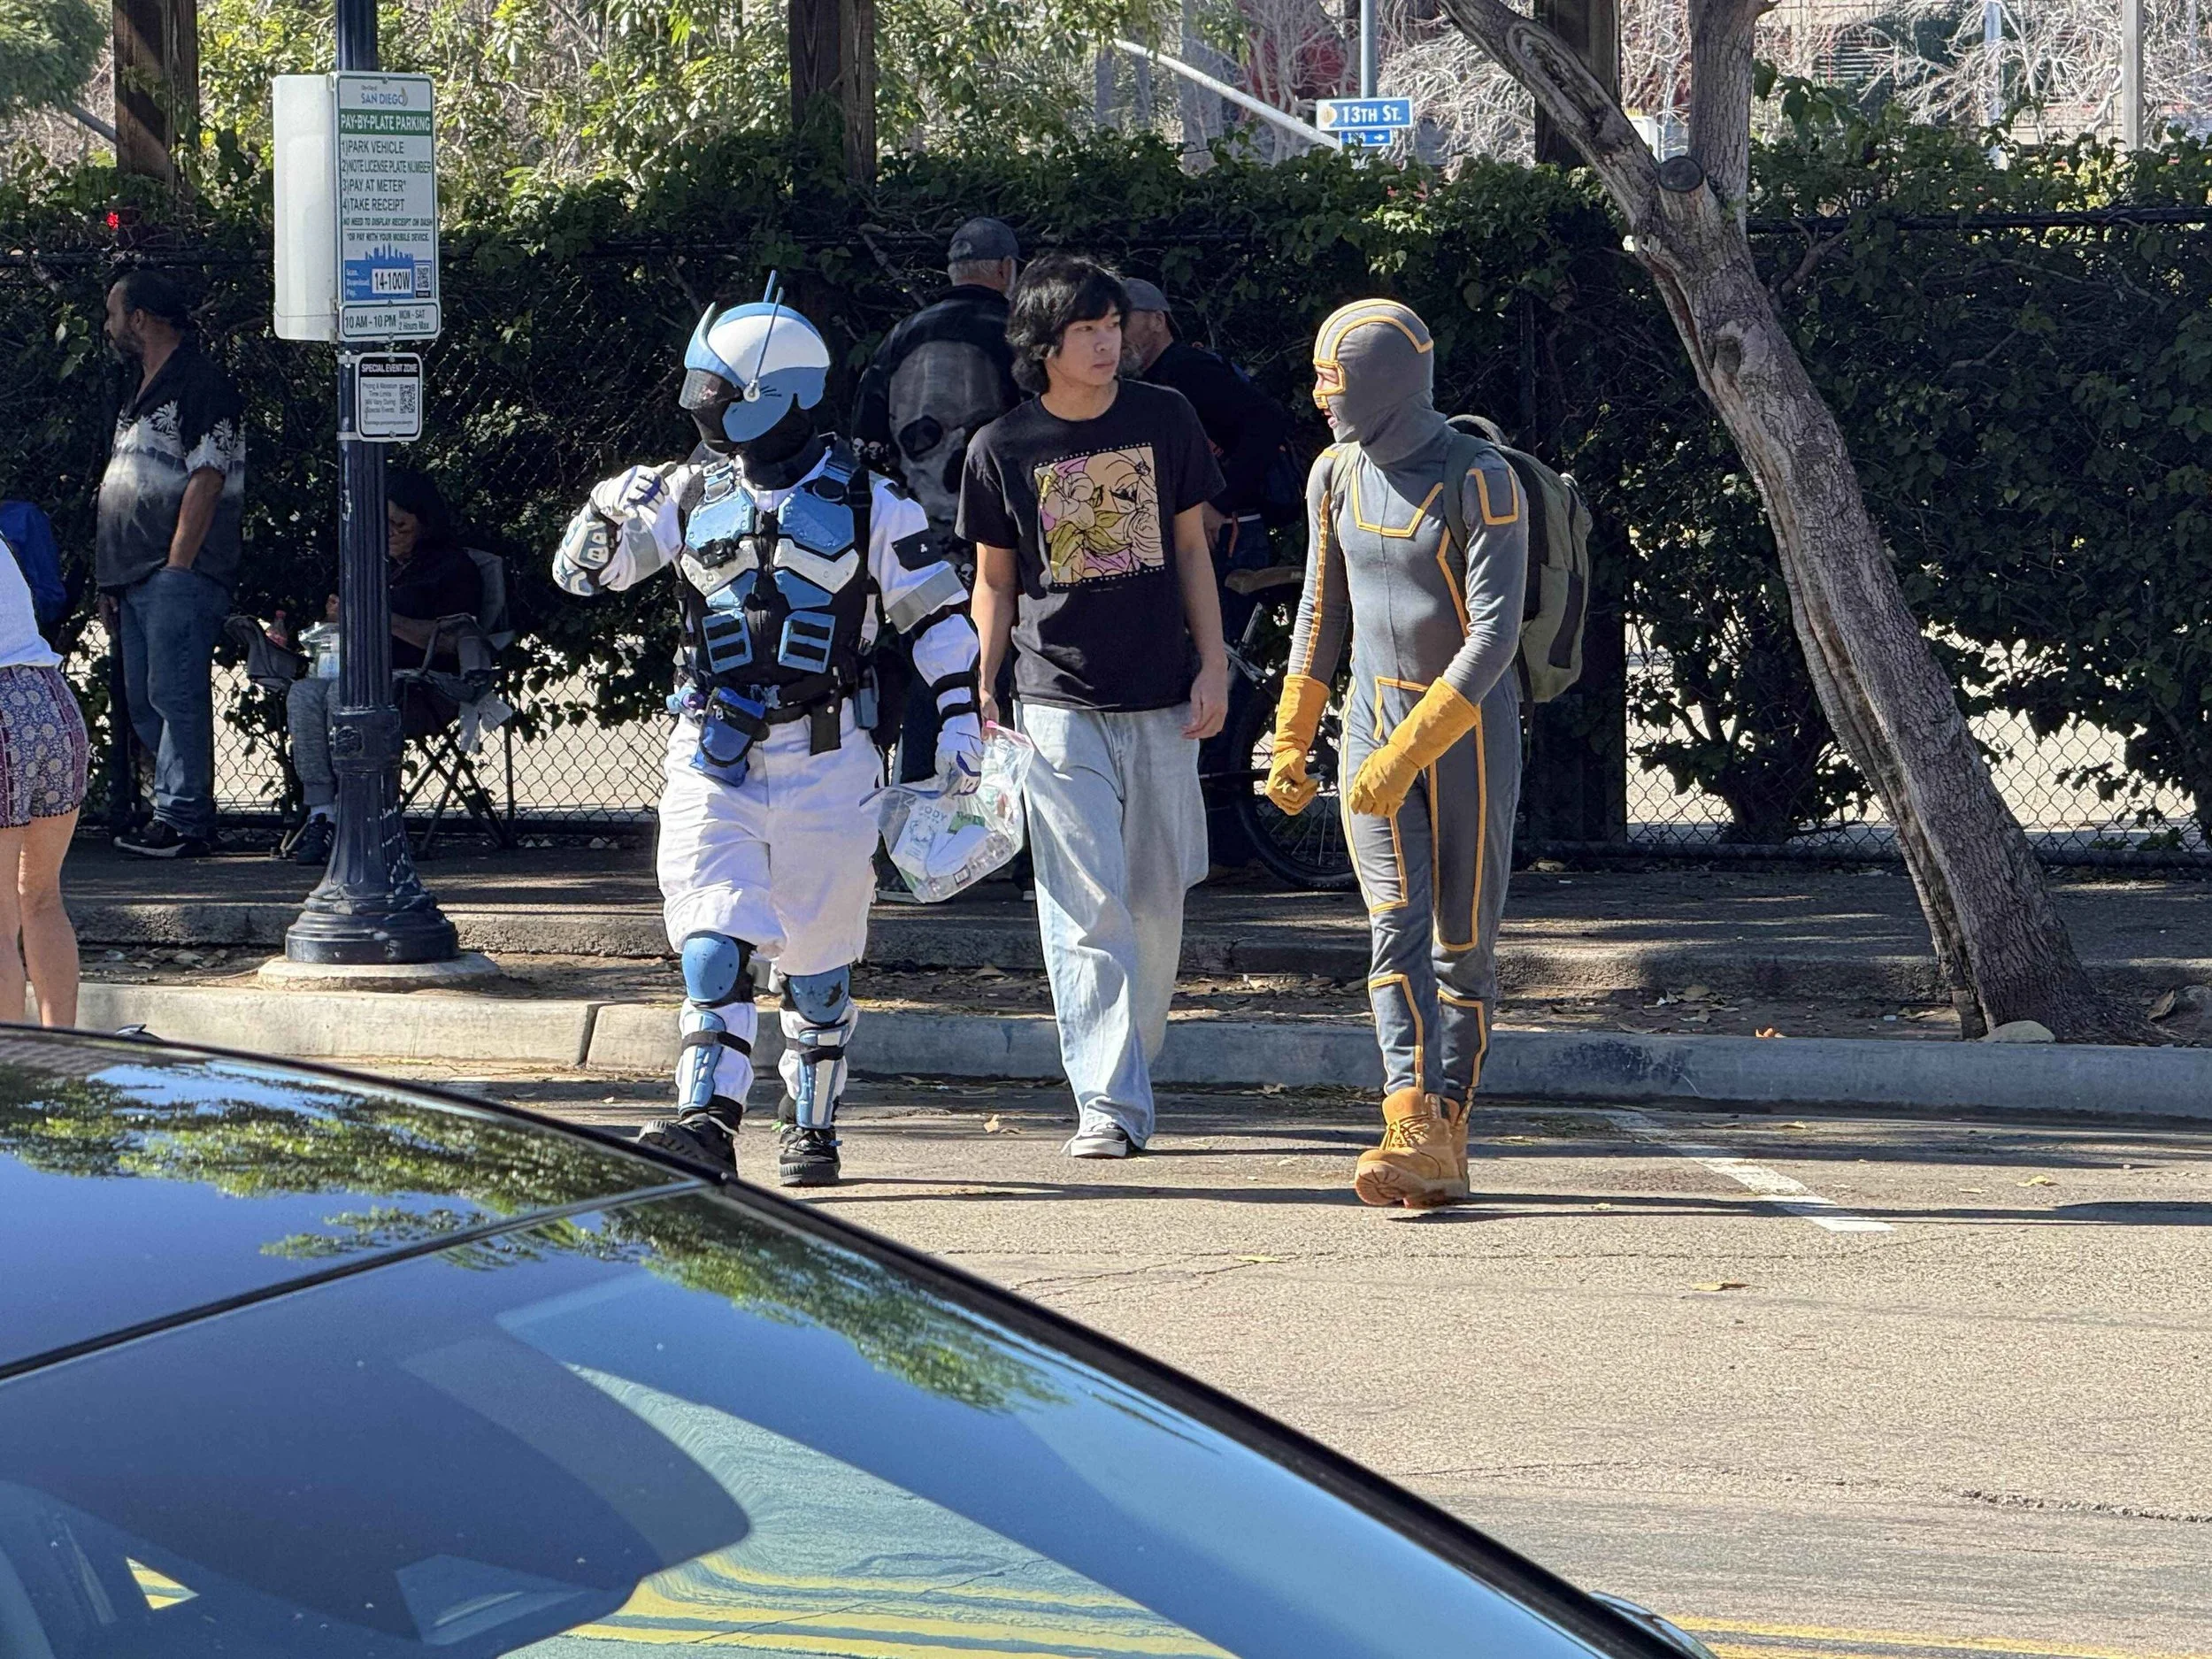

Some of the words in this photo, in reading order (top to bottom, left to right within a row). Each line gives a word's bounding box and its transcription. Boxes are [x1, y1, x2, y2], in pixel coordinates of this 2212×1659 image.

[361, 93, 378, 104] SAN
[380, 94, 404, 105] DIEGO
[1342, 106, 1378, 123] 13TH
[341, 114, 395, 131] PAY-BY-PLATE
[396, 115, 431, 131] PARKING
[371, 141, 404, 154] VEHICLE
[365, 159, 388, 173] LICENSE
[389, 160, 407, 173] PLATE
[407, 161, 432, 173] NUMBER
[365, 179, 375, 192] AT
[372, 198, 405, 211] RECEIPT
[392, 218, 411, 227] RECEIPT
[366, 233, 378, 242] WITH
[379, 233, 392, 242] YOUR
[393, 233, 410, 242] MOBILE
[374, 272, 411, 291] 14-100W
[398, 310, 411, 319] MON
[415, 310, 426, 319] SAT
[345, 317, 354, 329] 10
[355, 315, 368, 328] AM
[373, 315, 382, 327] 10
[384, 314, 396, 327] PM
[398, 322, 403, 331] 2
[403, 321, 418, 331] Hours
[419, 321, 429, 330] Max
[361, 364, 386, 373] SPECIAL
[386, 364, 403, 373] EVENT
[403, 364, 418, 373] ZONE
